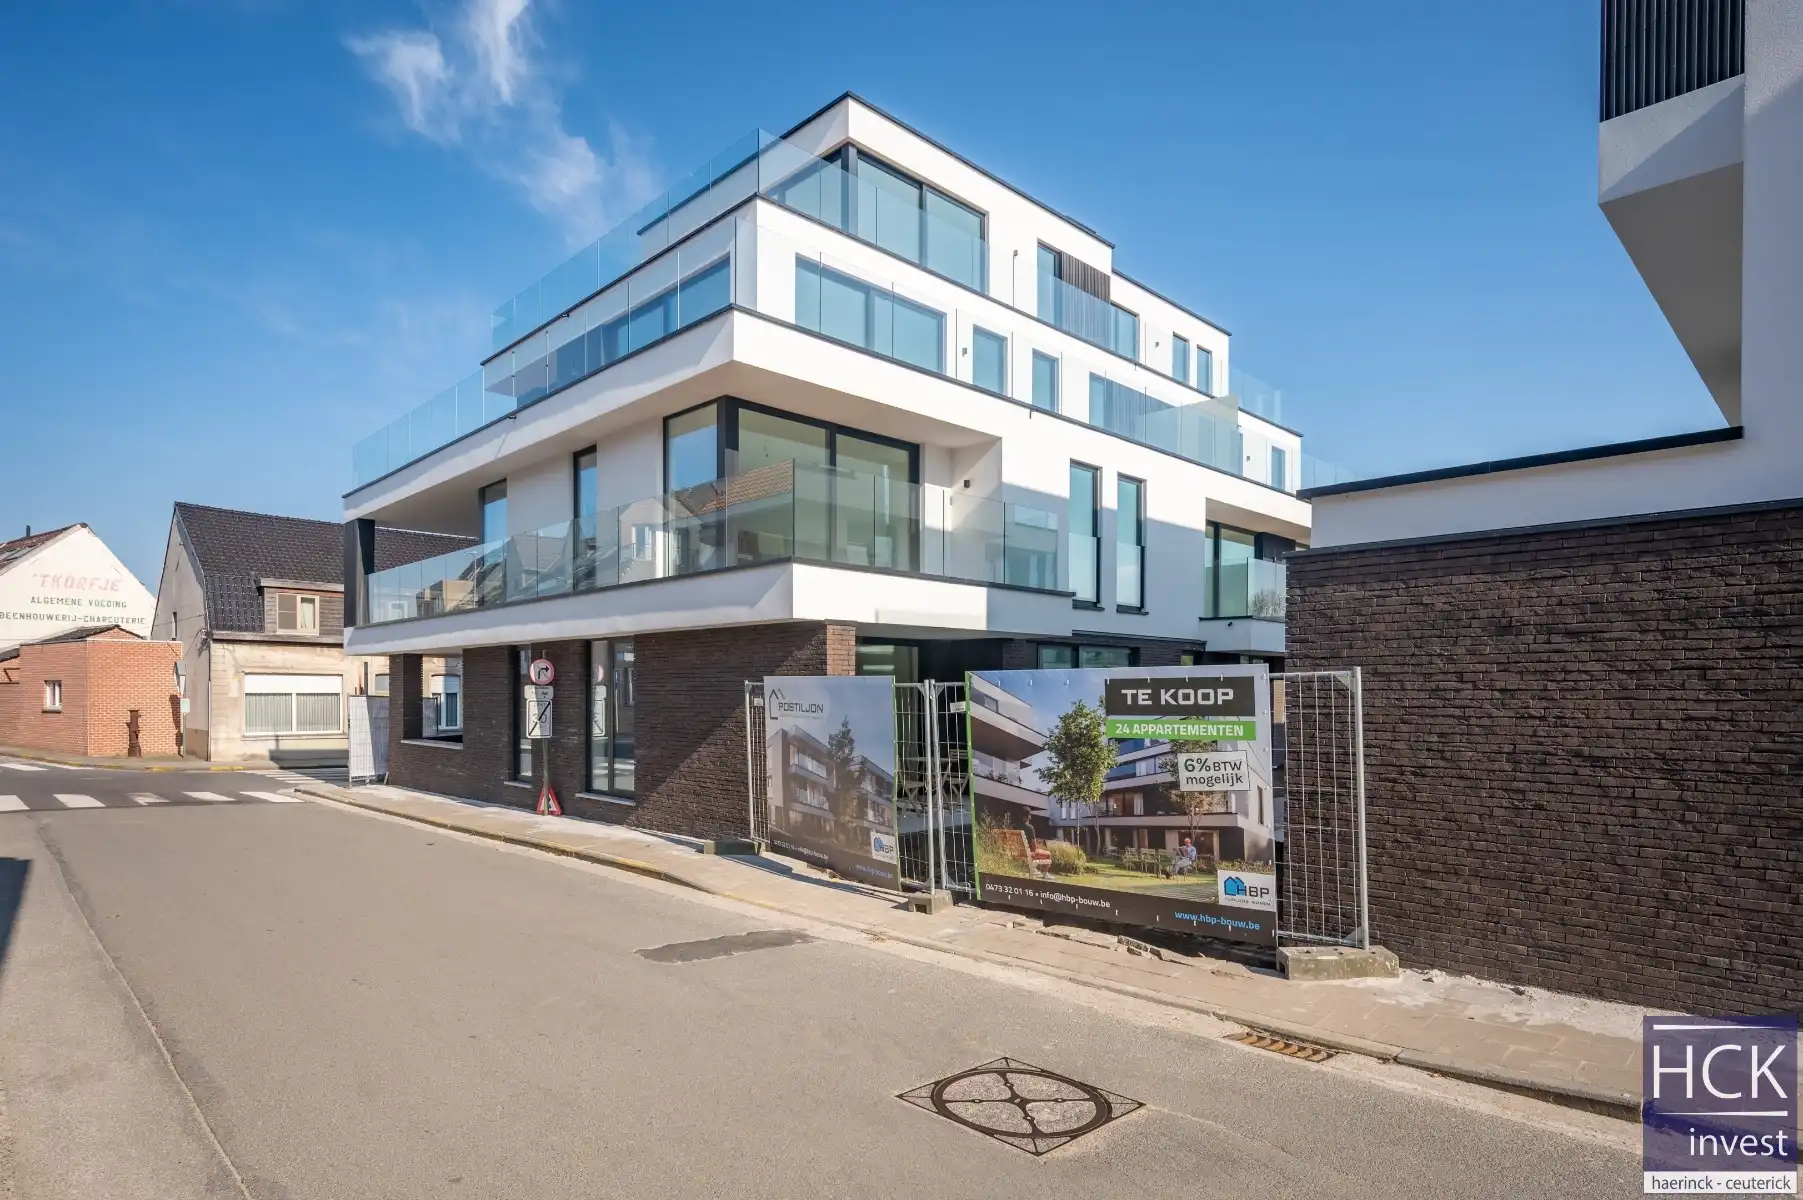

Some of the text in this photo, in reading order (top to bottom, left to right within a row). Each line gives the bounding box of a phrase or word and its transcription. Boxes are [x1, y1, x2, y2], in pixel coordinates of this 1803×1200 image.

[30, 596, 127, 608] ALGEMENE VOEDING
[1121, 688, 1234, 705] TE KOOP
[778, 702, 824, 714] POSTILJON
[1115, 723, 1244, 737] 24 APPARTEMENTEN
[1186, 773, 1243, 788] mogelijk
[985, 883, 1111, 908] 0473 32 01 16 info@hbp-bouw.be
[1236, 884, 1270, 898] HBP
[1174, 911, 1260, 930] www.hbp-bouw.be
